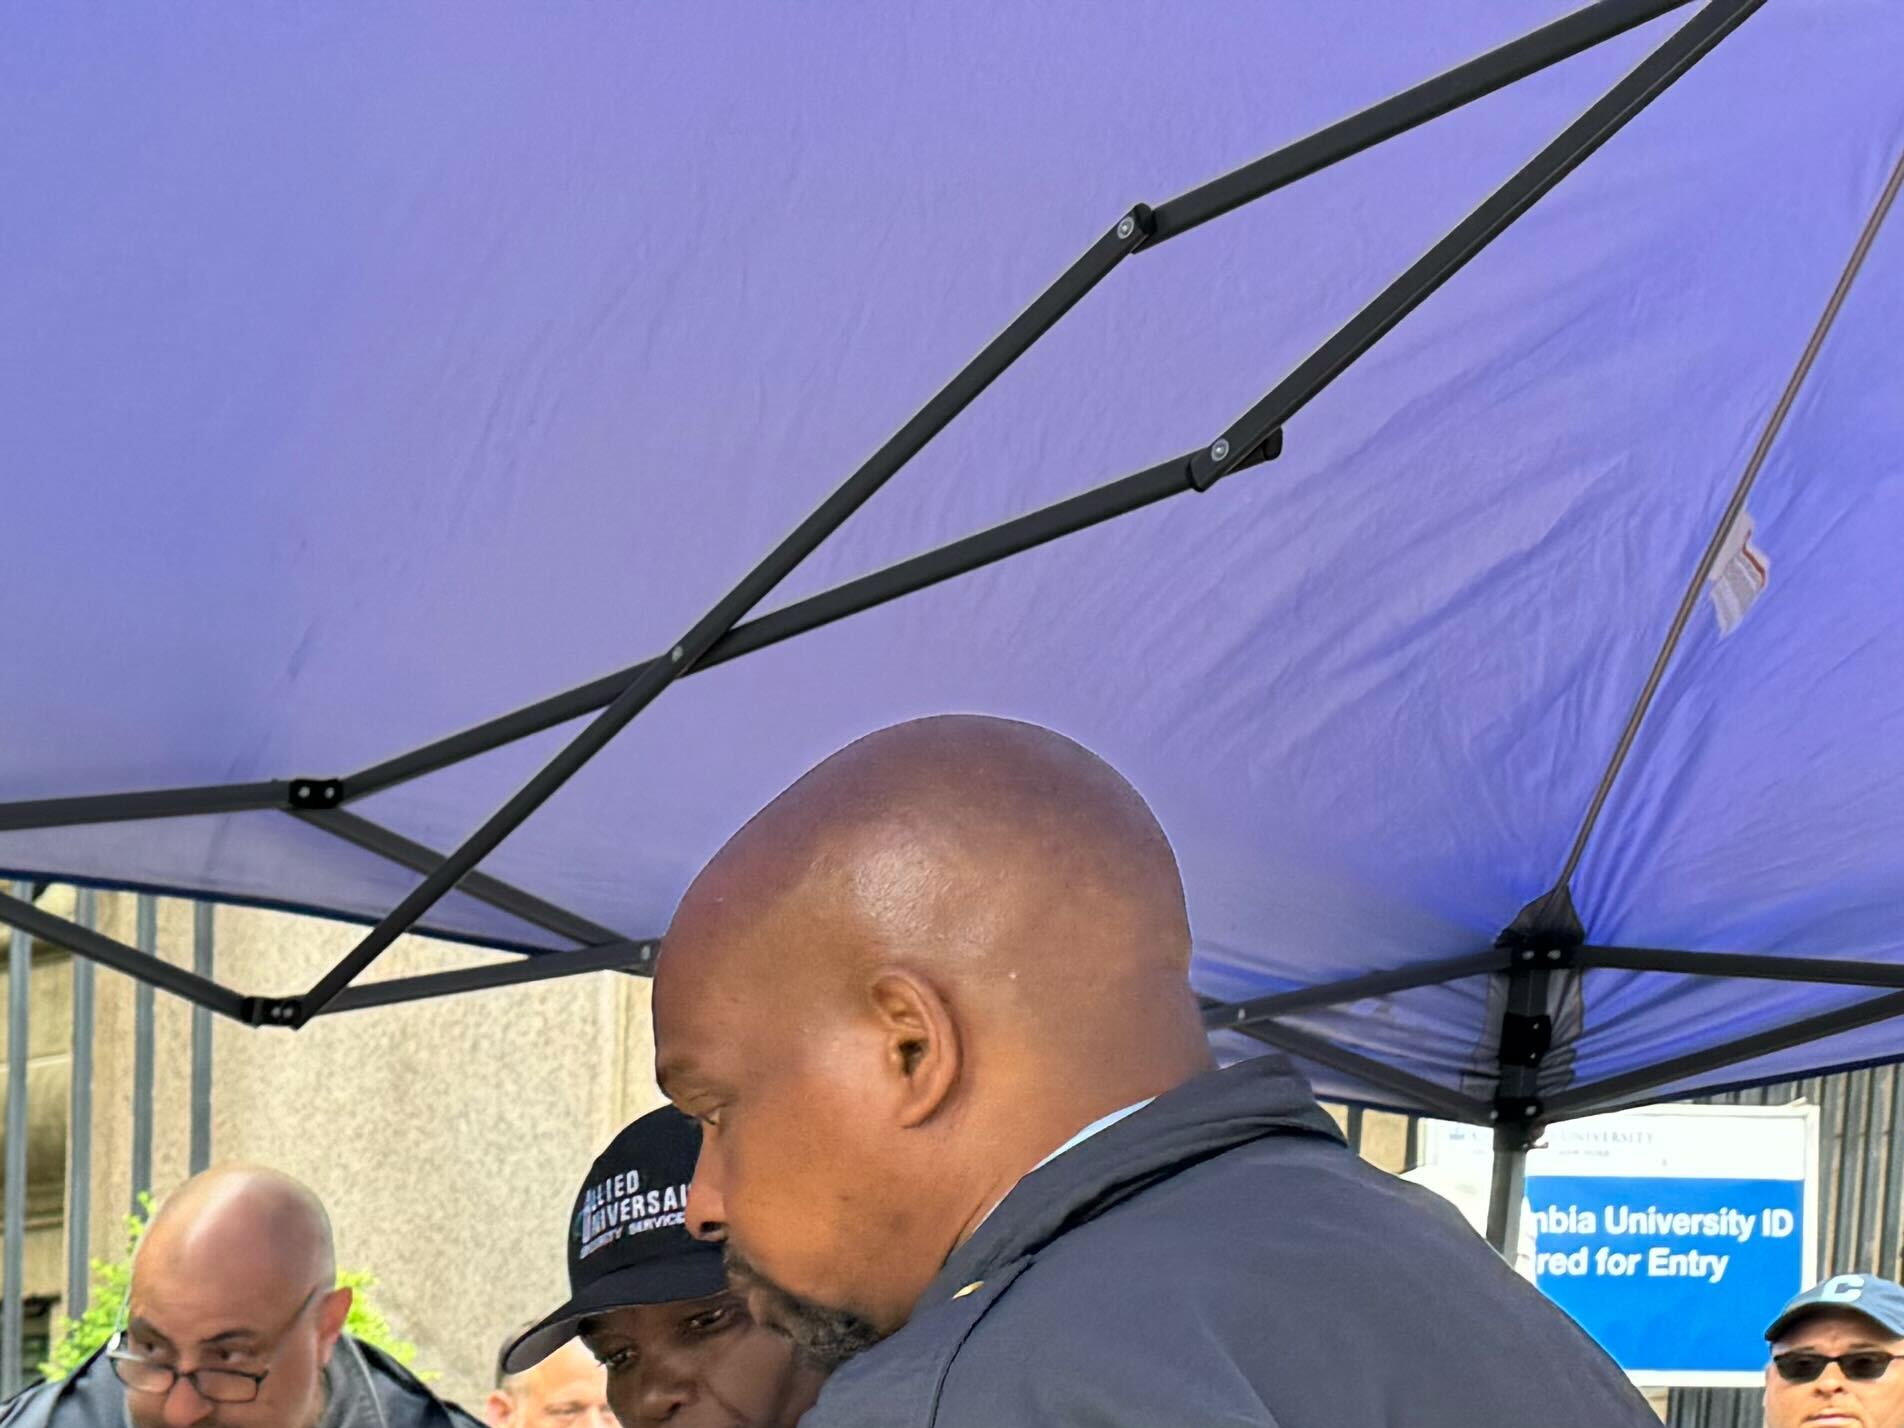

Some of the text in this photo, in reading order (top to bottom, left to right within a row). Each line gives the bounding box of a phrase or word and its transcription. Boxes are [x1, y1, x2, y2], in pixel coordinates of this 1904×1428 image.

[583, 1170, 640, 1207] ALLIED
[627, 1211, 686, 1235] SERVICE
[1604, 1205, 1757, 1242] University
[1762, 1209, 1794, 1238] ID
[1594, 1247, 1642, 1277] for
[1647, 1247, 1730, 1284] Entry
[1820, 1273, 1865, 1303] C
